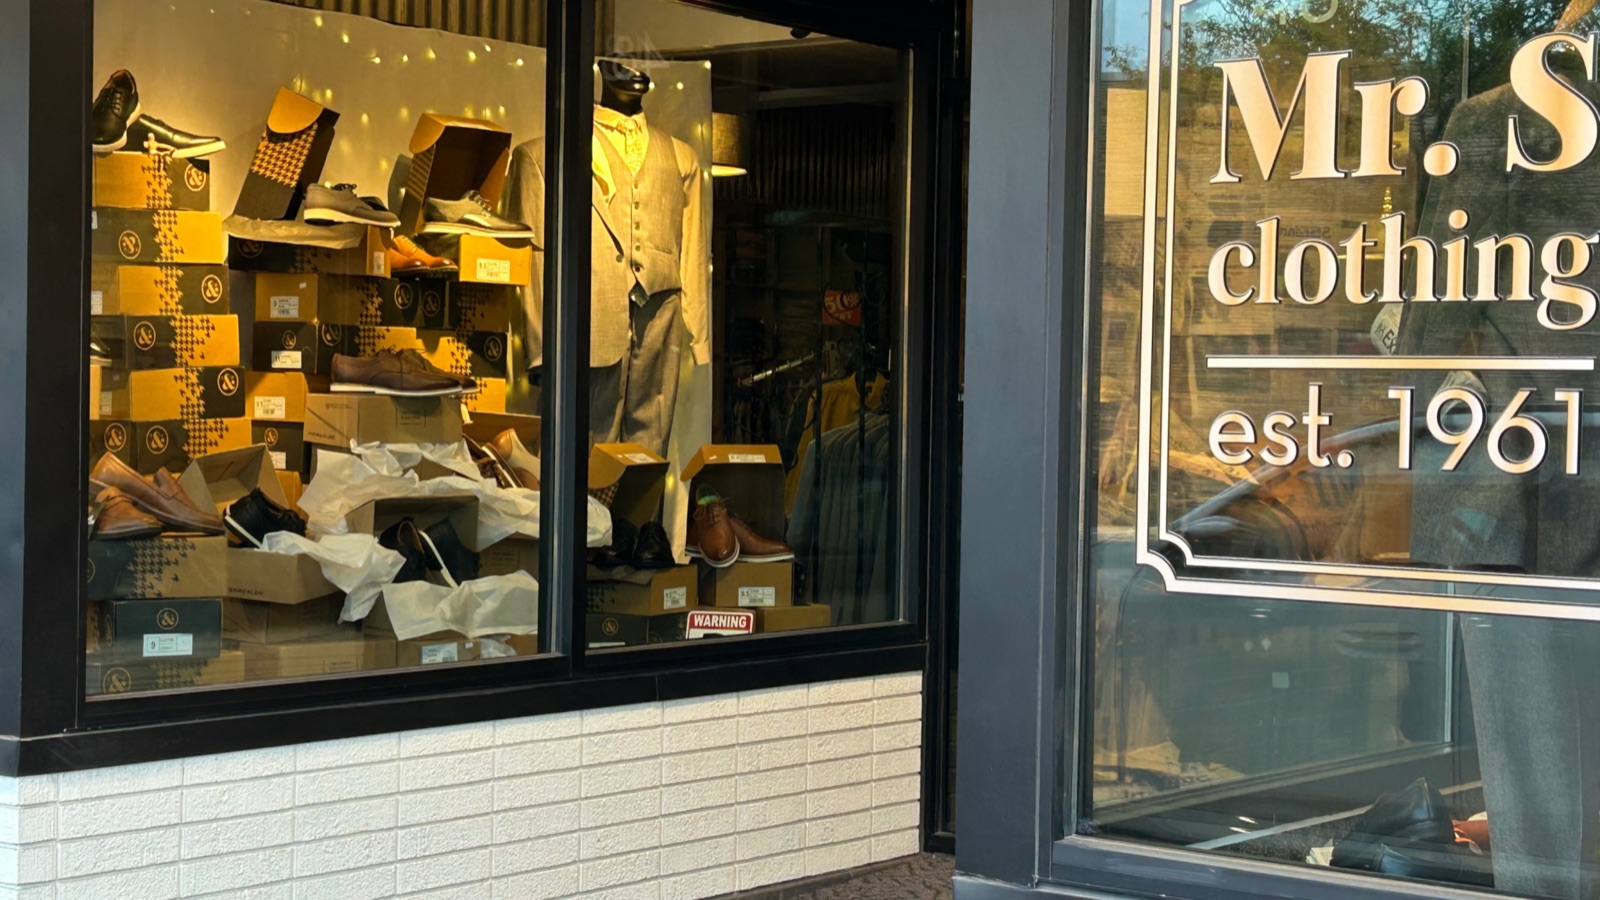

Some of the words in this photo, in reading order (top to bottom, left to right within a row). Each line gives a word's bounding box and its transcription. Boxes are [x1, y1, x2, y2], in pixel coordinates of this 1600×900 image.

[1209, 49, 1460, 184] Mr.
[1505, 31, 1600, 173] S
[1207, 209, 1600, 331] clothing
[1208, 382, 1355, 469] est.
[1387, 387, 1584, 475] 1961
[150, 640, 156, 650] 9
[694, 614, 747, 628] WARNING
